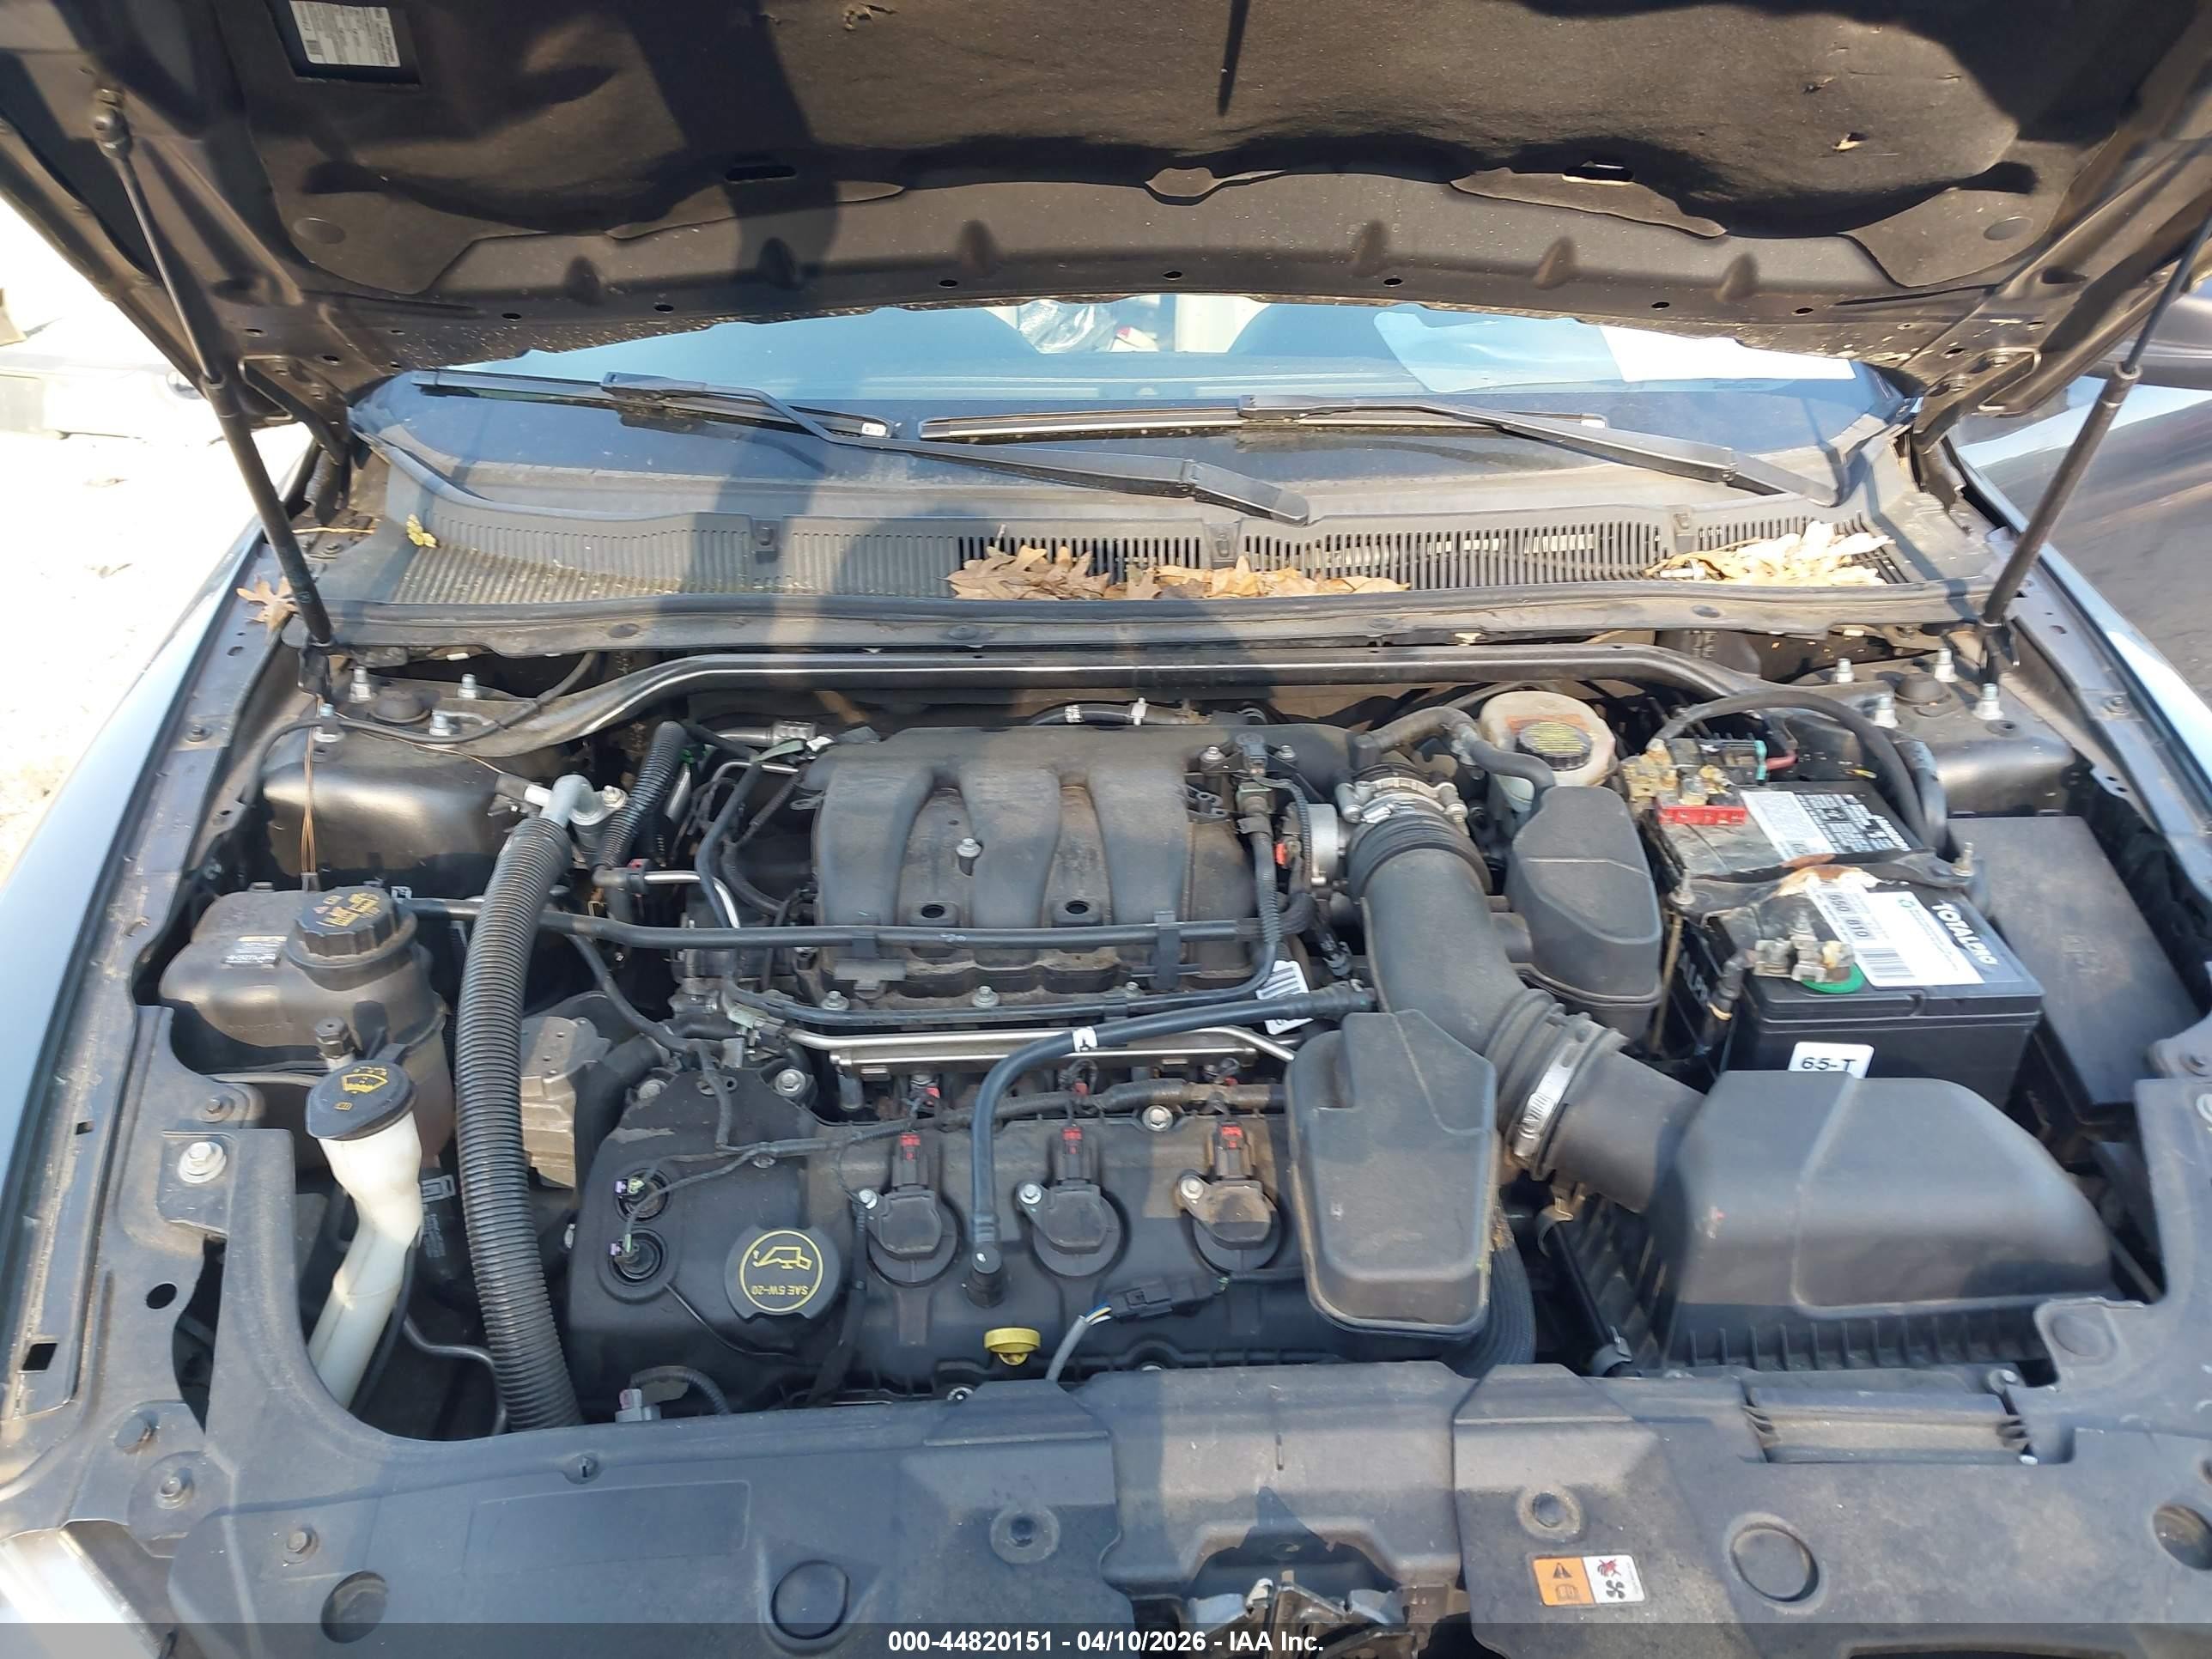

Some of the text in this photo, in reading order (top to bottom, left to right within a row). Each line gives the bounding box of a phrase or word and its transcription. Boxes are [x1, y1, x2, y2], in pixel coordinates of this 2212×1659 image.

[1932, 901, 1999, 965] TOTALPRO
[1802, 1057, 1857, 1072] 65-T
[752, 1285, 809, 1296] SAE 5W-20
